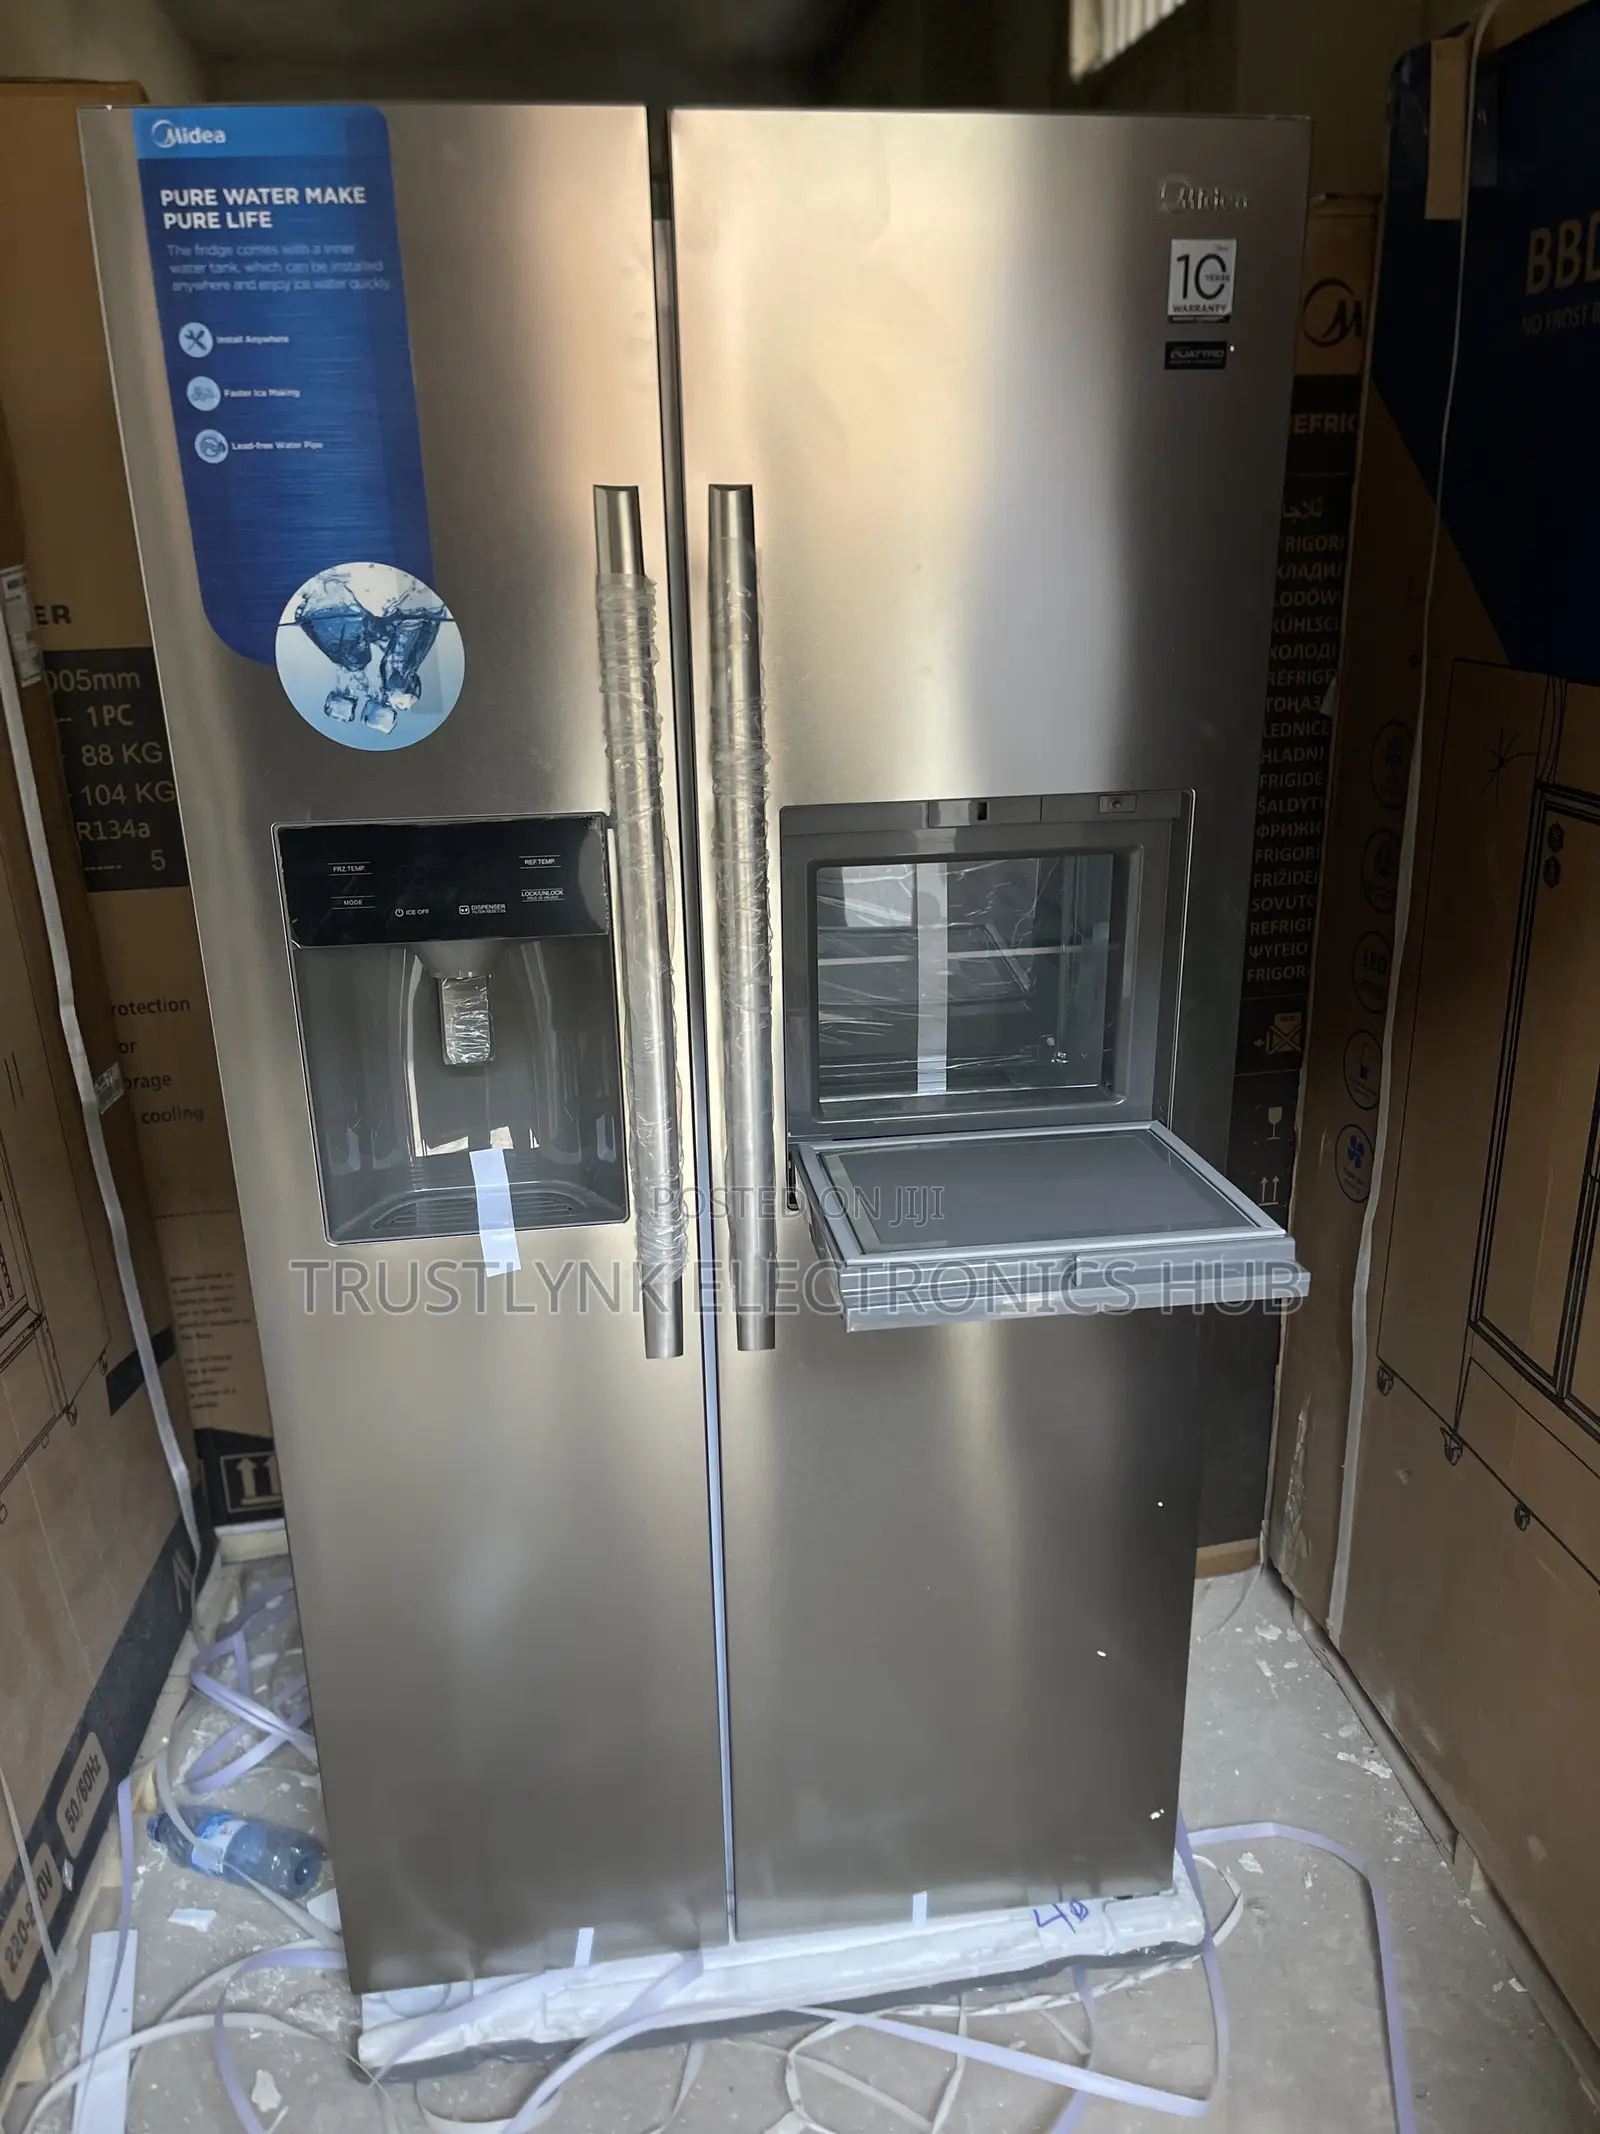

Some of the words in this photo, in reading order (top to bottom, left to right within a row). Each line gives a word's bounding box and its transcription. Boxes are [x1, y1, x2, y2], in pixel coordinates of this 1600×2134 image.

[152, 119, 226, 148] Midea
[160, 188, 218, 206] PURE
[223, 187, 299, 205] WATER
[305, 186, 367, 204] MAKE
[163, 211, 221, 229] PURE
[226, 211, 273, 228] LIFE
[1177, 253, 1226, 300] 10
[1172, 303, 1226, 313] WARRANTY
[81, 744, 114, 767] 88
[121, 741, 164, 765] KG
[80, 783, 127, 807] 104
[134, 780, 176, 804] KG
[76, 819, 151, 842] R134a
[151, 849, 167, 871] 5
[1247, 964, 1310, 983] FRIGOR
[1364, 948, 1387, 975] LED
[141, 1104, 204, 1124] cooling
[65, 1753, 101, 1834] 50/60Hz
[4, 1859, 53, 1974] 220-20V
